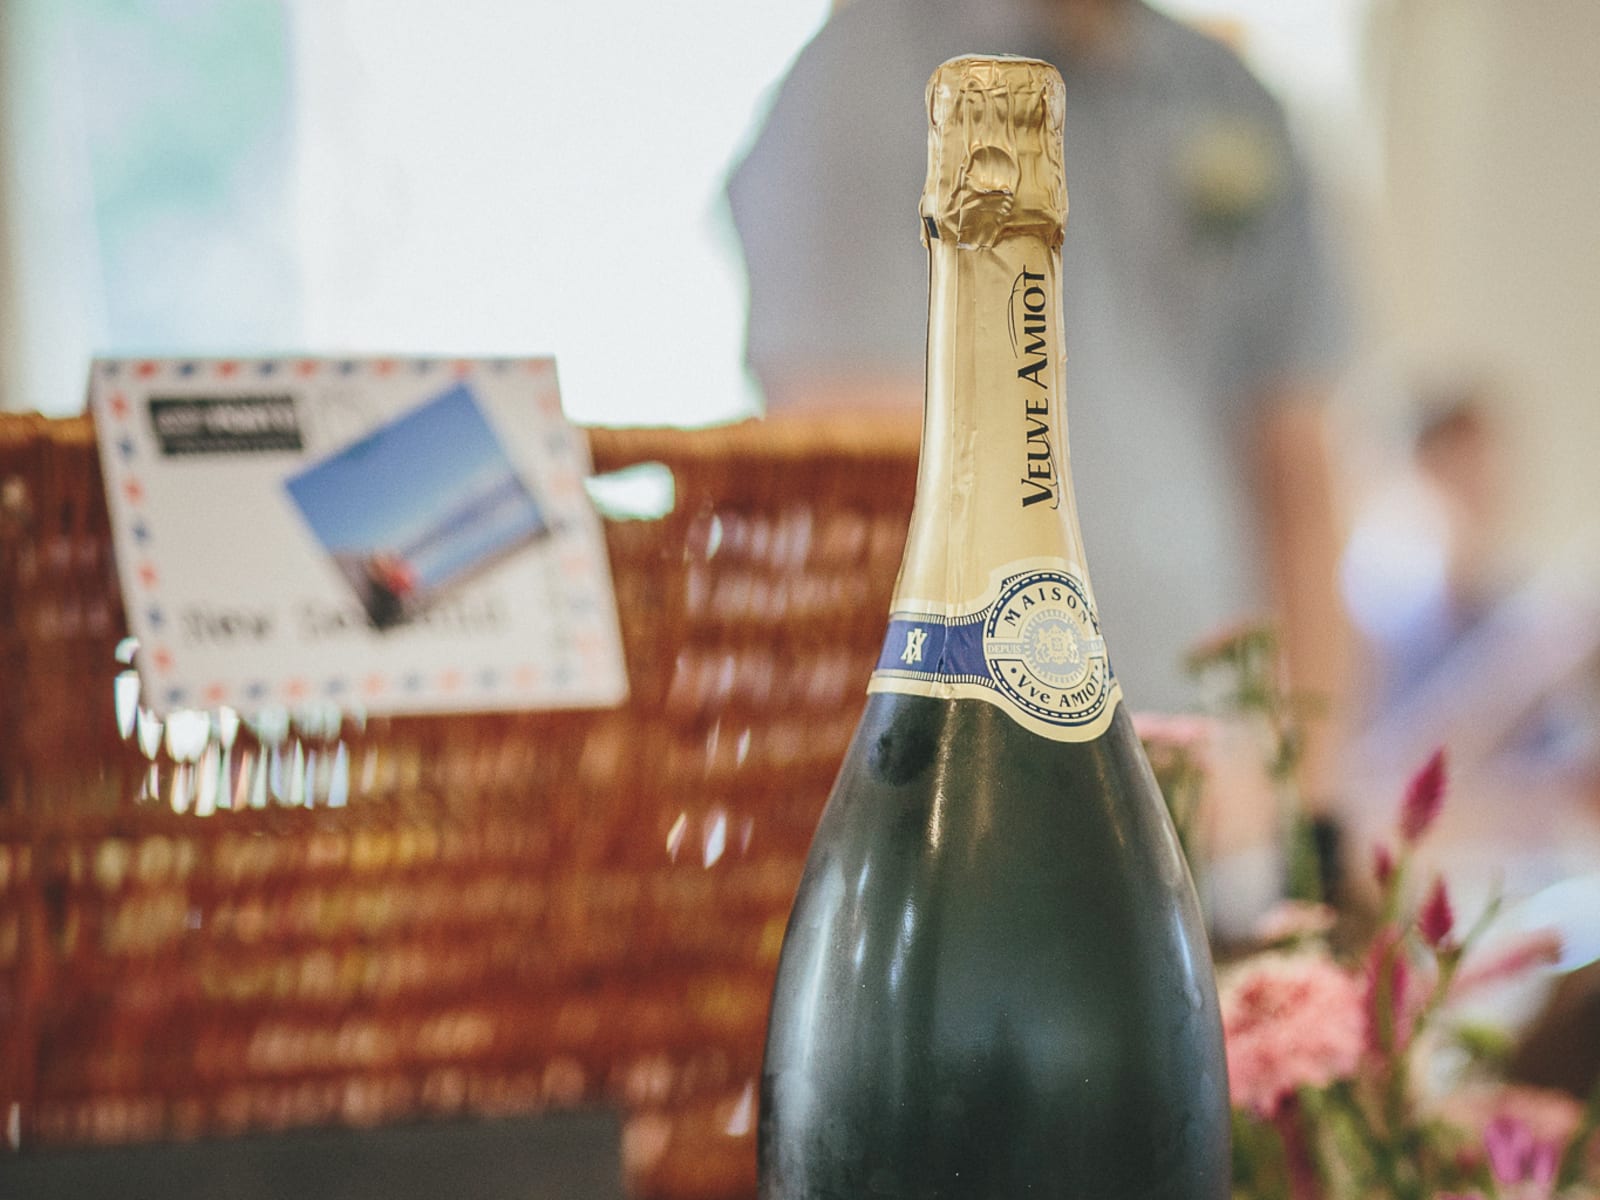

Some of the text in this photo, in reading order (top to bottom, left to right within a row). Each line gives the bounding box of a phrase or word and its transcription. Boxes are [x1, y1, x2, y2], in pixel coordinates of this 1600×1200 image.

[1008, 264, 1059, 509] VEUVE AMIOT
[1004, 587, 1087, 626] MAISON
[988, 643, 1022, 654] DEPUIS
[1018, 673, 1100, 707] Vve AMIOT
